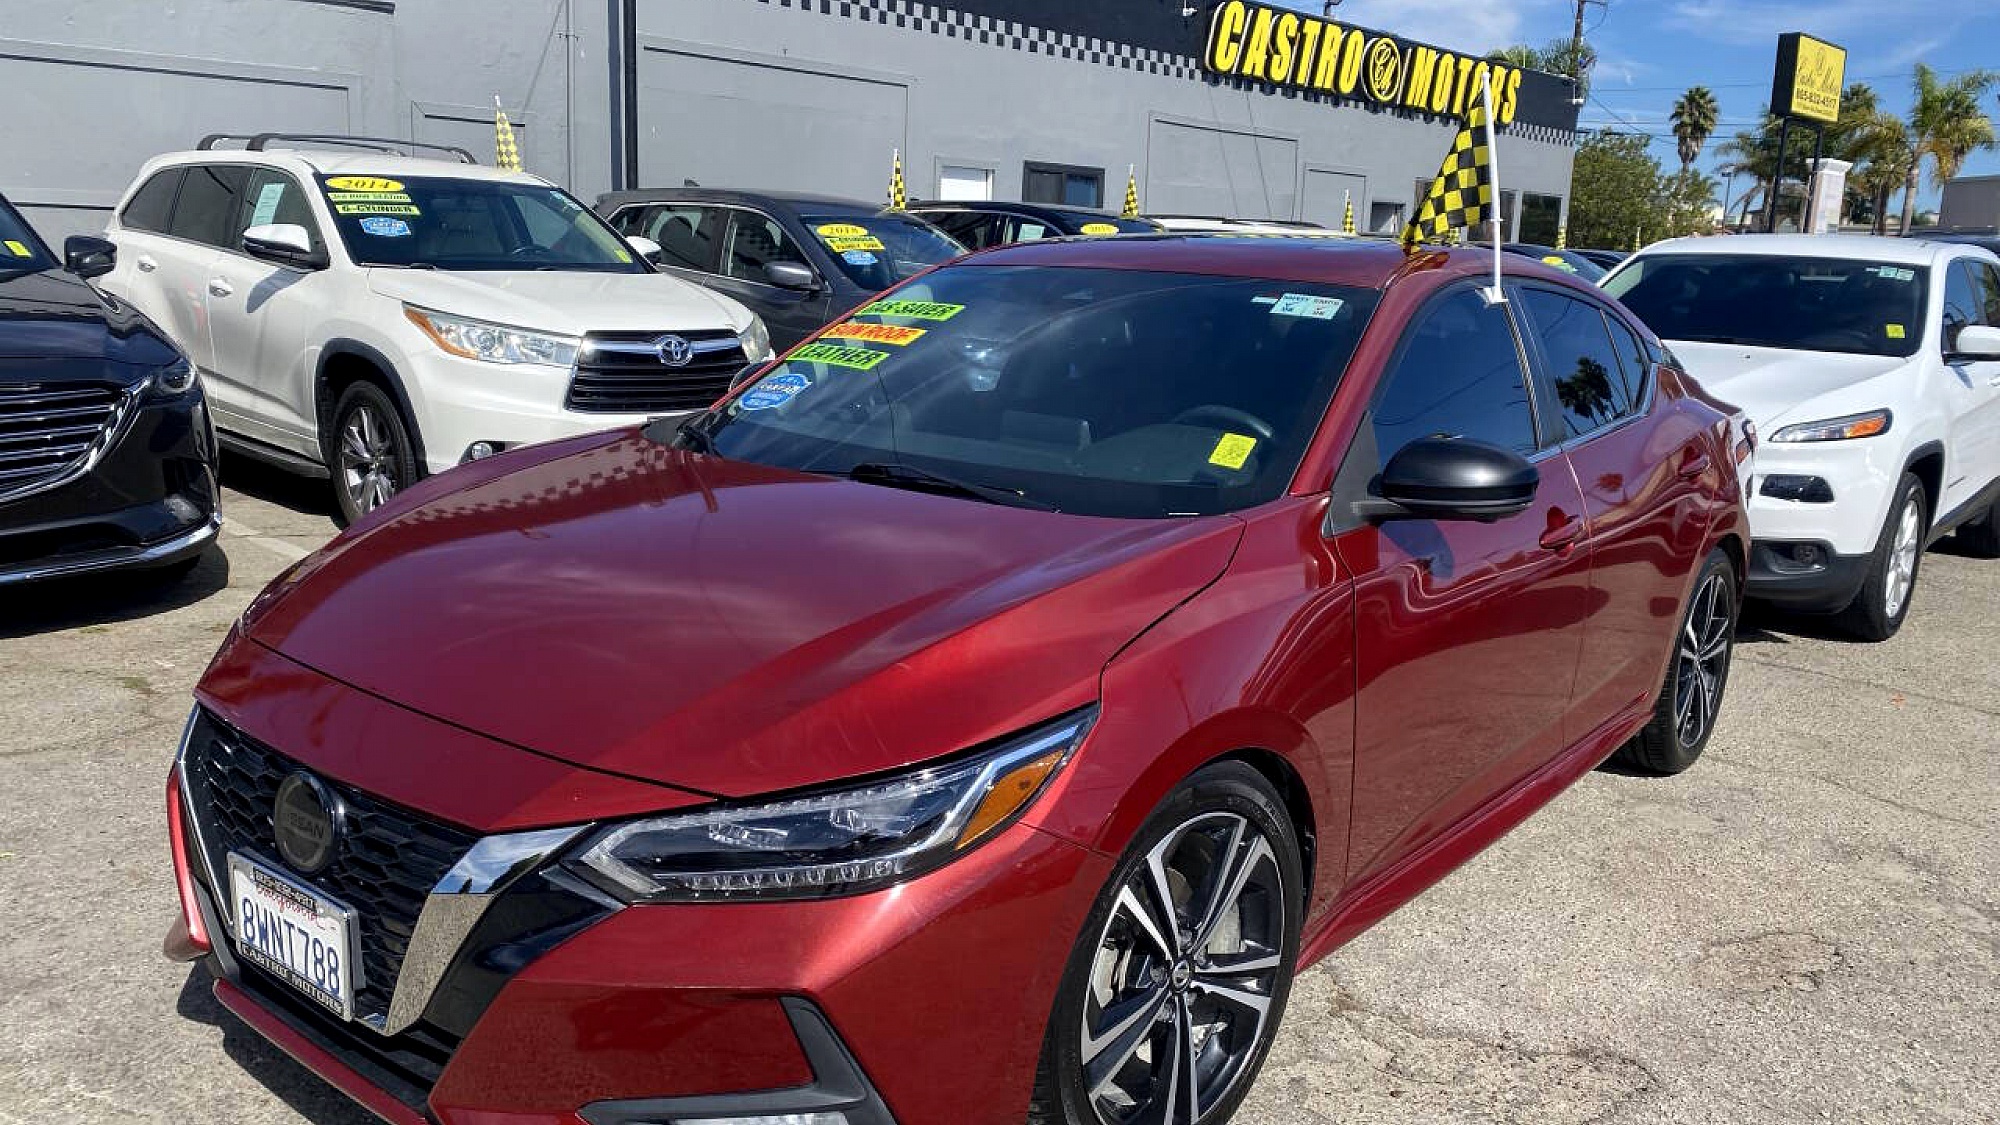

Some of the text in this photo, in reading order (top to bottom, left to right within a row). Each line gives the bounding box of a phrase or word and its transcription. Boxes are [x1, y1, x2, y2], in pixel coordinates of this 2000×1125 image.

[1213, 0, 1365, 94] CASTRO
[1407, 45, 1522, 125] MOTORS
[343, 178, 392, 189] 2014
[796, 344, 883, 365] LEATHER
[241, 945, 343, 1016] CASTRO MOTORS
[242, 897, 340, 998] 8WNT788
